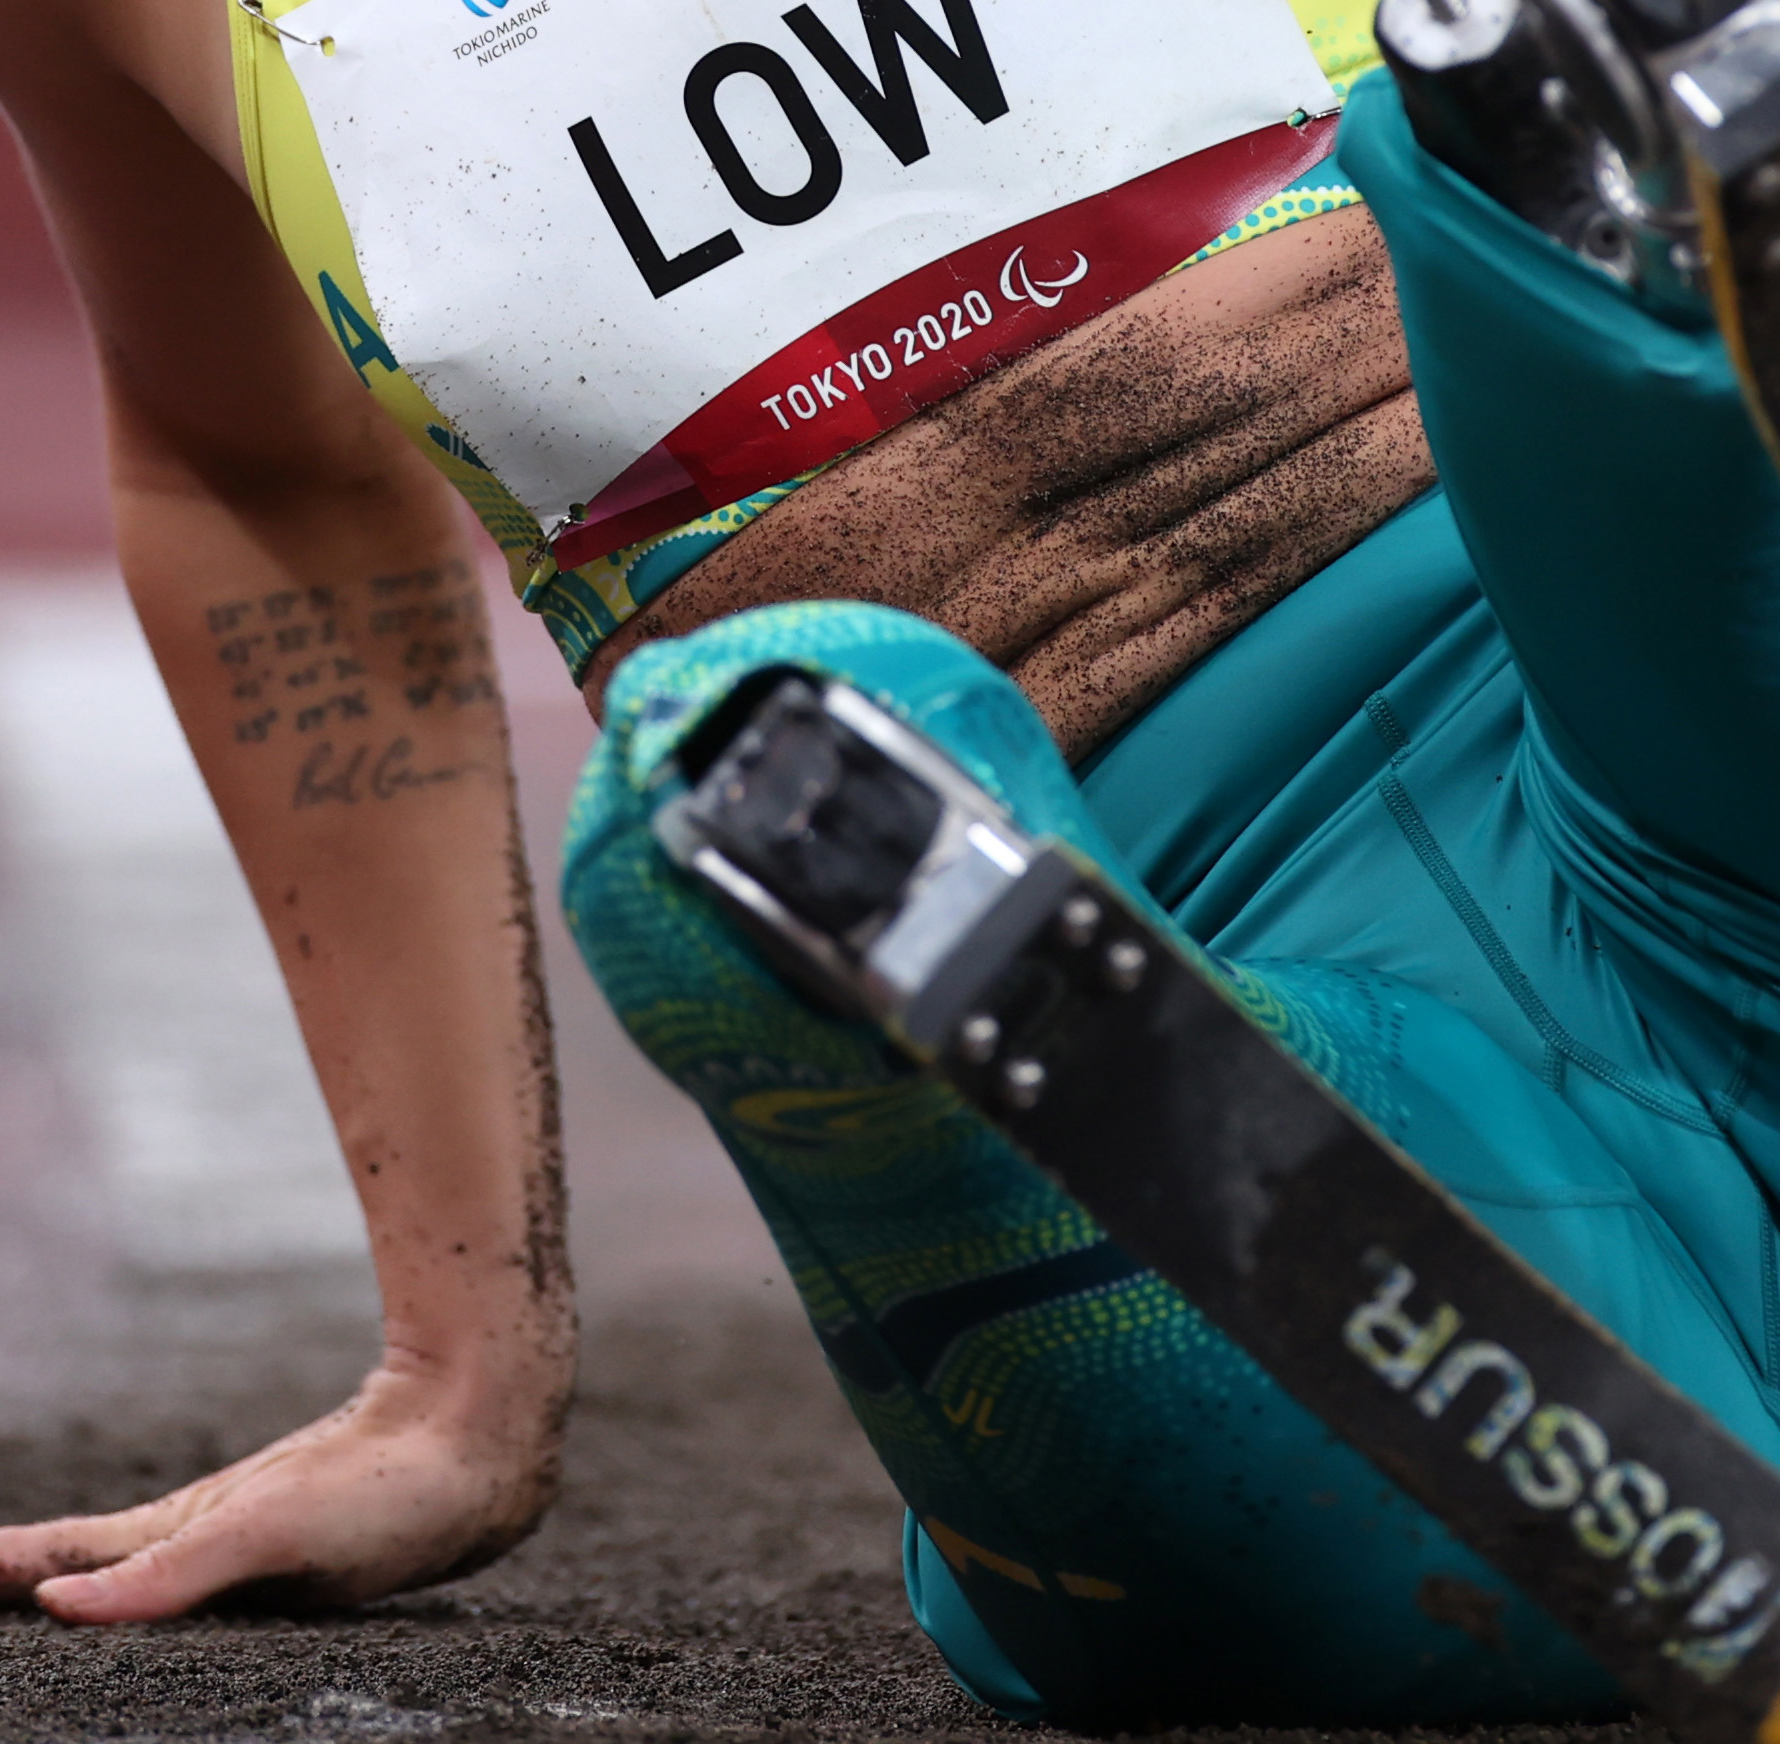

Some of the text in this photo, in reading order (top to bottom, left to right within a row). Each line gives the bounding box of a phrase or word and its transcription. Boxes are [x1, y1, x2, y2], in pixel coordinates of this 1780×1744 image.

[453, 0, 551, 60] TOKIO MARINE
[477, 26, 538, 67] NICHIDO
[760, 289, 993, 431] TOKYO 2020
